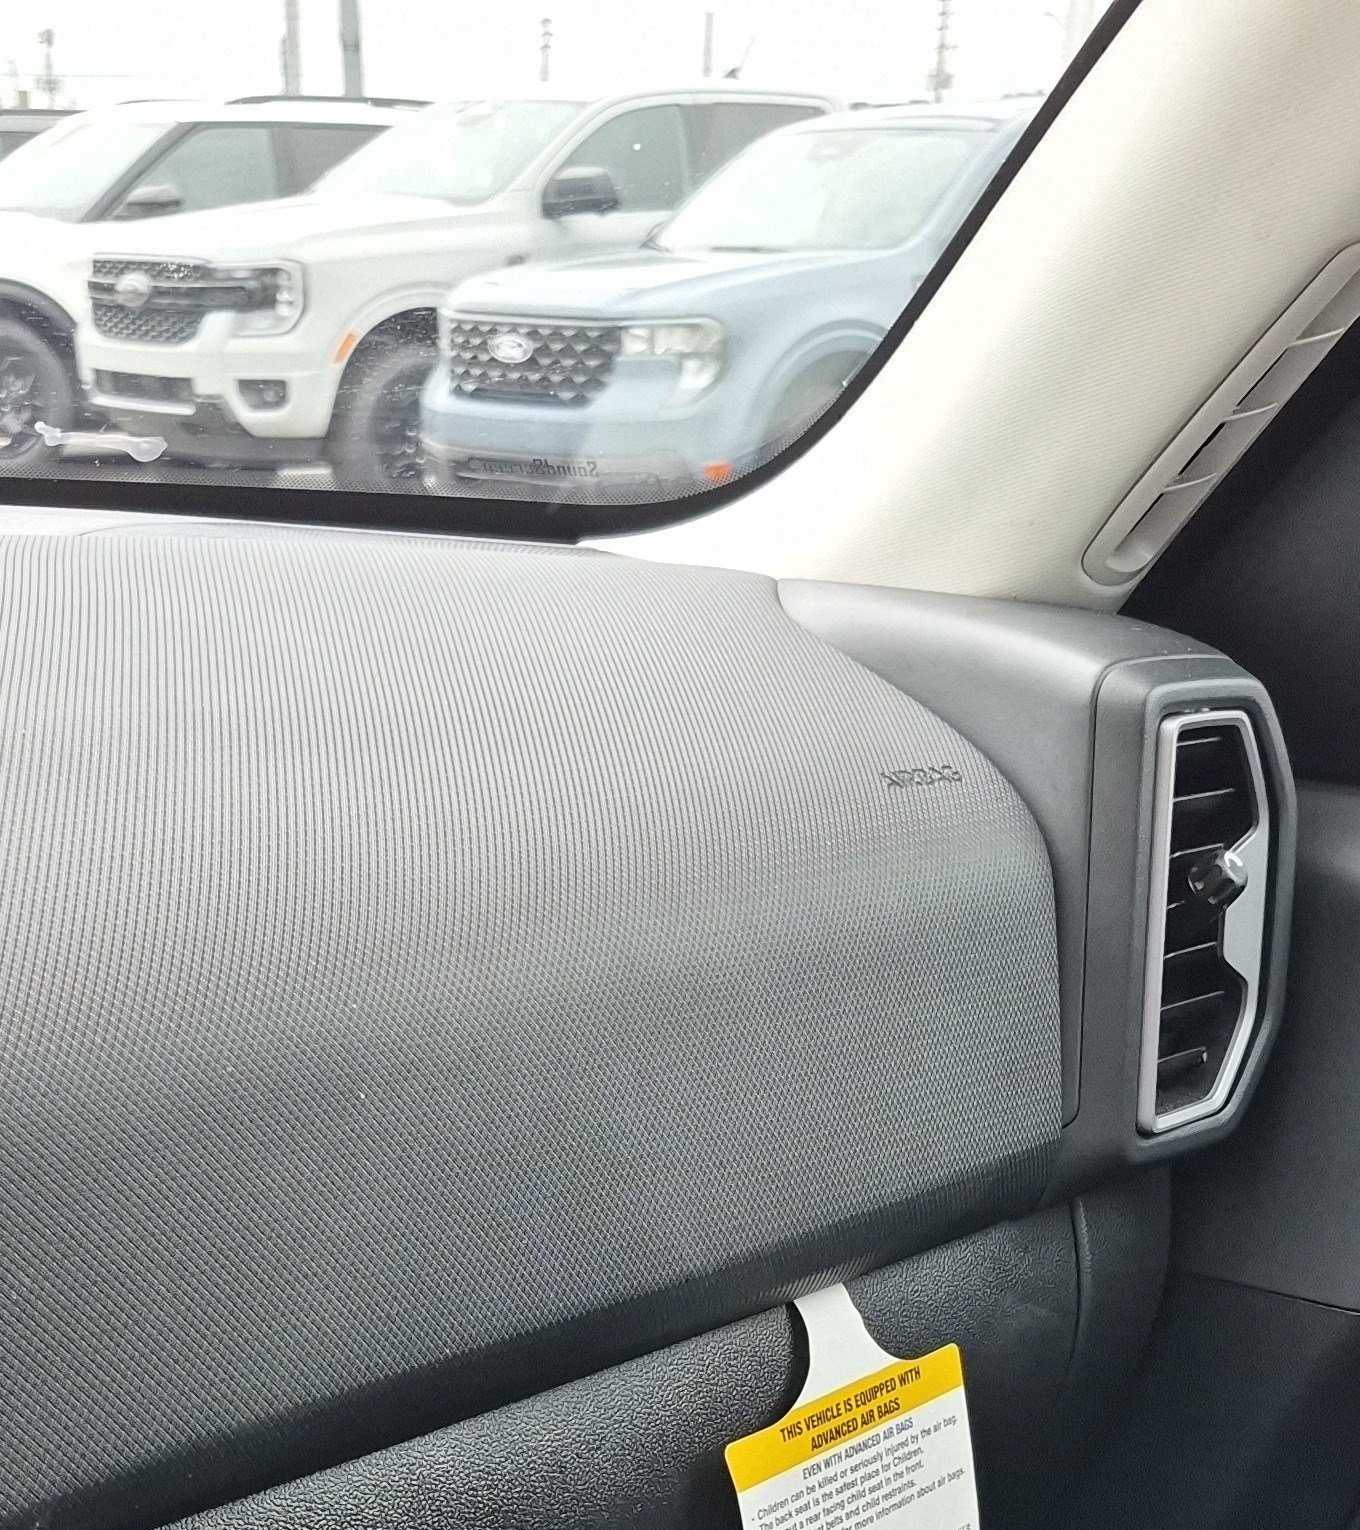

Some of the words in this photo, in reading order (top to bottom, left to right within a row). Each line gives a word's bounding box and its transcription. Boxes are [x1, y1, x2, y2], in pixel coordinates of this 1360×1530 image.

[780, 1421, 803, 1442] THIS
[804, 1402, 842, 1431] VEHICLE
[843, 1398, 853, 1414] IS
[854, 1378, 896, 1408] EQUIPPED
[898, 1366, 921, 1387] WITH
[811, 1417, 858, 1451] ADVANCED
[860, 1410, 875, 1428] AIR
[878, 1397, 900, 1419] BAGS
[757, 1498, 789, 1520] Children
[791, 1490, 804, 1503] can
[806, 1484, 816, 1495] be
[818, 1472, 838, 1489] killed
[840, 1468, 847, 1478] or
[850, 1451, 883, 1474] seriously
[885, 1437, 909, 1456] injured
[910, 1433, 919, 1444] by
[920, 1427, 932, 1438] the
[933, 1421, 942, 1432] air
[803, 1461, 822, 1480] EVEN
[823, 1454, 842, 1470] WITH
[845, 1433, 881, 1460] ADVANCED
[883, 1427, 894, 1442] AIR
[896, 1417, 914, 1434] BAGS
[775, 1510, 793, 1526] back
[795, 1501, 811, 1516] seat
[813, 1497, 820, 1507] is
[821, 1491, 833, 1503] the
[835, 1478, 858, 1496] safest
[860, 1468, 880, 1486] place
[882, 1462, 891, 1473] for
[893, 1447, 924, 1467] Children.
[799, 1520, 804, 1529] a
[805, 1512, 821, 1526] rear
[822, 1500, 845, 1517] facing
[847, 1487, 866, 1504] child
[868, 1480, 883, 1495] seat
[885, 1477, 892, 1486] in
[893, 1470, 904, 1481] the
[826, 1515, 844, 1530] belts
[845, 1506, 860, 1521] and
[861, 1496, 880, 1513] child
[882, 1479, 917, 1502] restraints.
[854, 1515, 874, 1530] more
[875, 1493, 916, 1521] information
[916, 1481, 936, 1499] about
[937, 1476, 946, 1488] air
[947, 1468, 965, 1482] bags.
